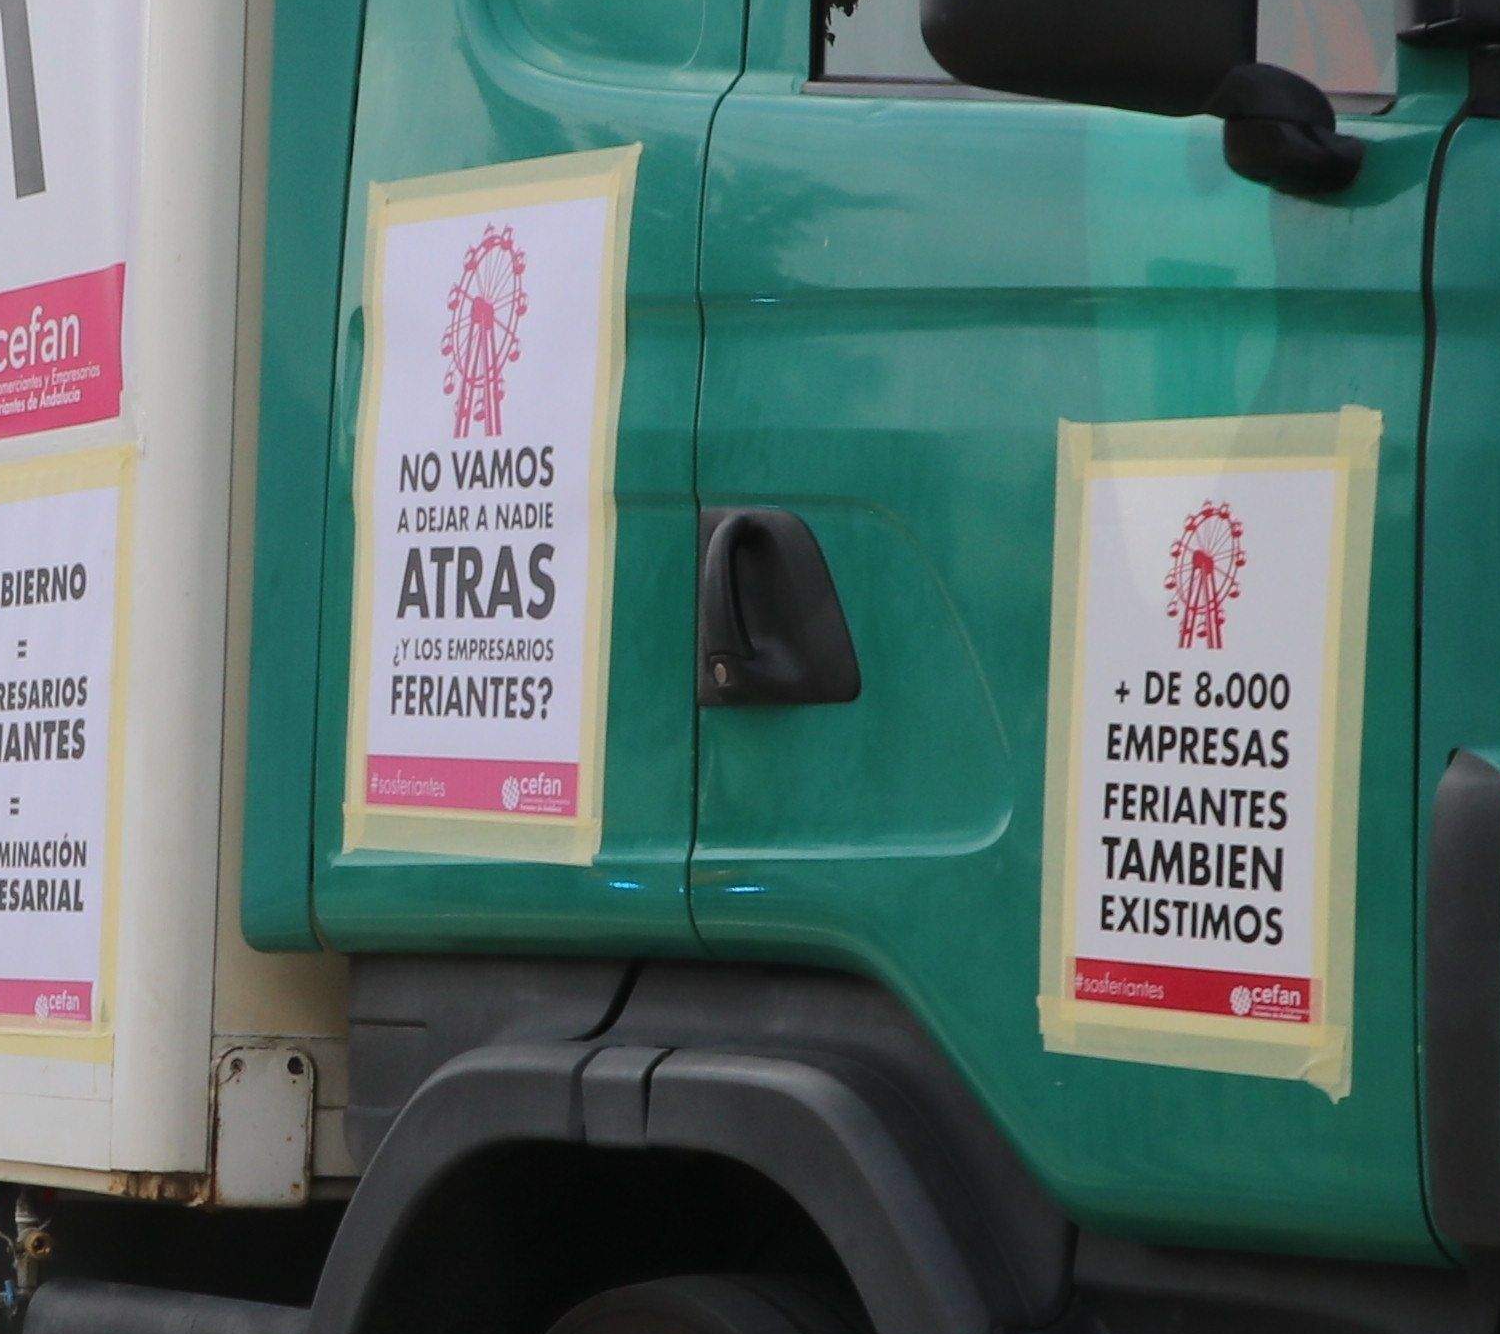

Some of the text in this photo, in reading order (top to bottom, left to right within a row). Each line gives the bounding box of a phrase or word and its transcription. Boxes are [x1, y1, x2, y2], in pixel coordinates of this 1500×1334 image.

[400, 445, 554, 492] NO VAMOS
[397, 502, 554, 533] A DEJAR A NADIE
[396, 543, 555, 620] ATRAS
[393, 638, 554, 667] ¿Y LOS EMPRESARIOS
[391, 674, 553, 720] FERIANTES?
[1145, 672, 1181, 706] DE
[1194, 670, 1290, 711] 8.000
[1107, 724, 1290, 769] EMPRESAS
[370, 770, 562, 798] #sosferiantes cefan
[1102, 783, 1288, 831] FERIANTES
[1101, 836, 1284, 892] TAMBIEN
[1100, 894, 1284, 946] EXISTIMOS
[50, 989, 80, 1011] cefan
[1074, 971, 1301, 1007] #sosferiantes cefan
